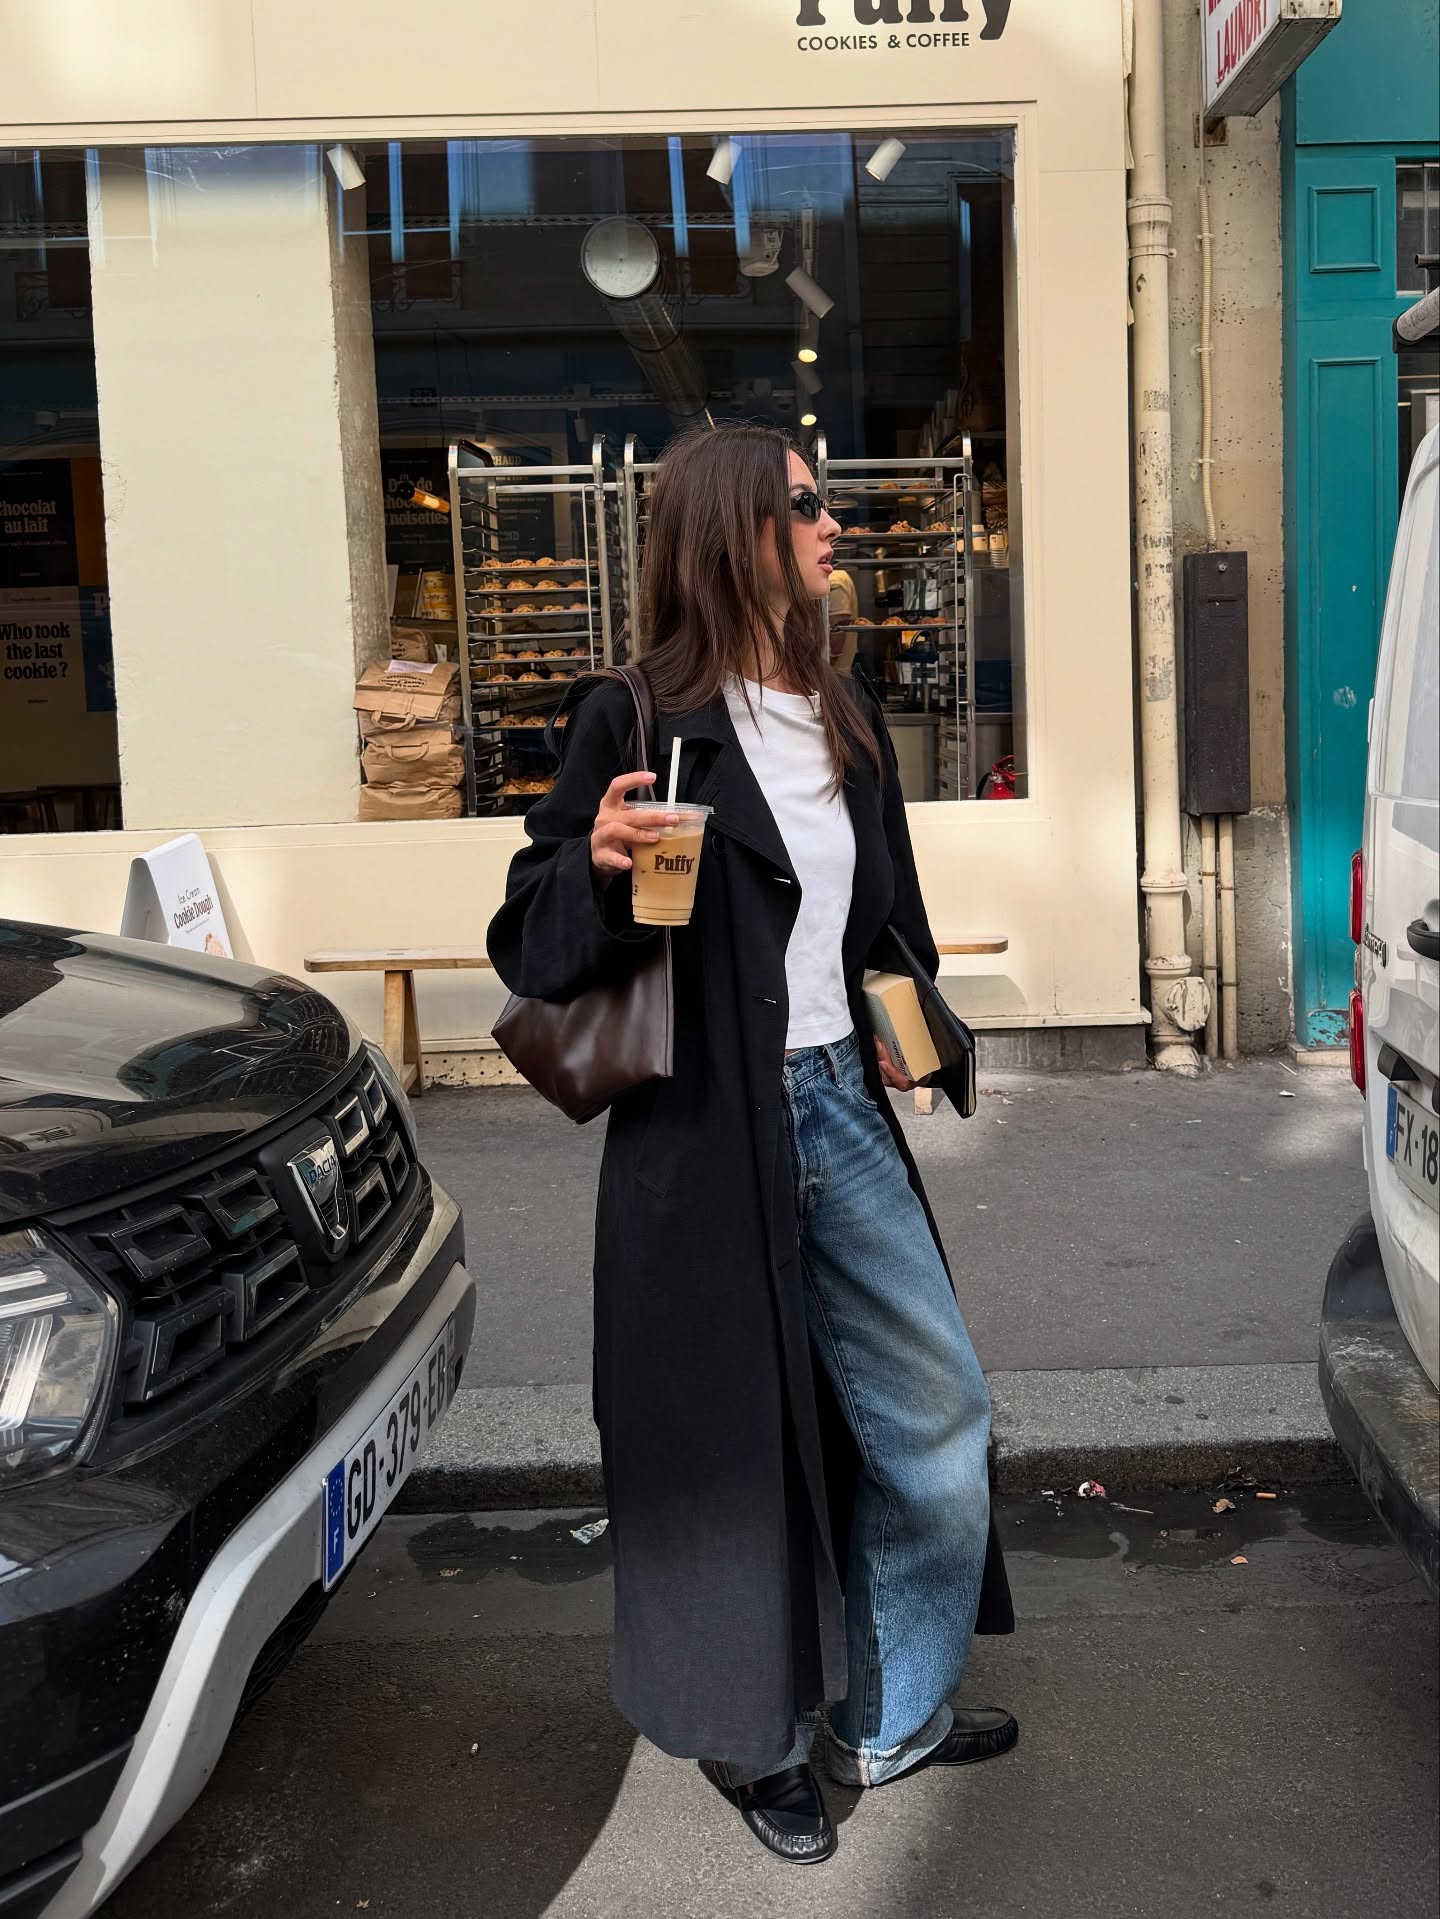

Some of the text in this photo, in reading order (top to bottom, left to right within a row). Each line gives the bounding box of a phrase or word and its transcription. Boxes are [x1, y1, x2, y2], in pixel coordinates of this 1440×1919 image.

[797, 32, 970, 51] COOKIES & COFFEE
[4, 517, 49, 534] au lait
[35, 621, 71, 639] took
[6, 642, 64, 660] the last
[654, 854, 695, 875] Puffy
[174, 905, 195, 928] Cookie
[193, 894, 213, 917] Dough
[308, 1154, 337, 1185] DACIA
